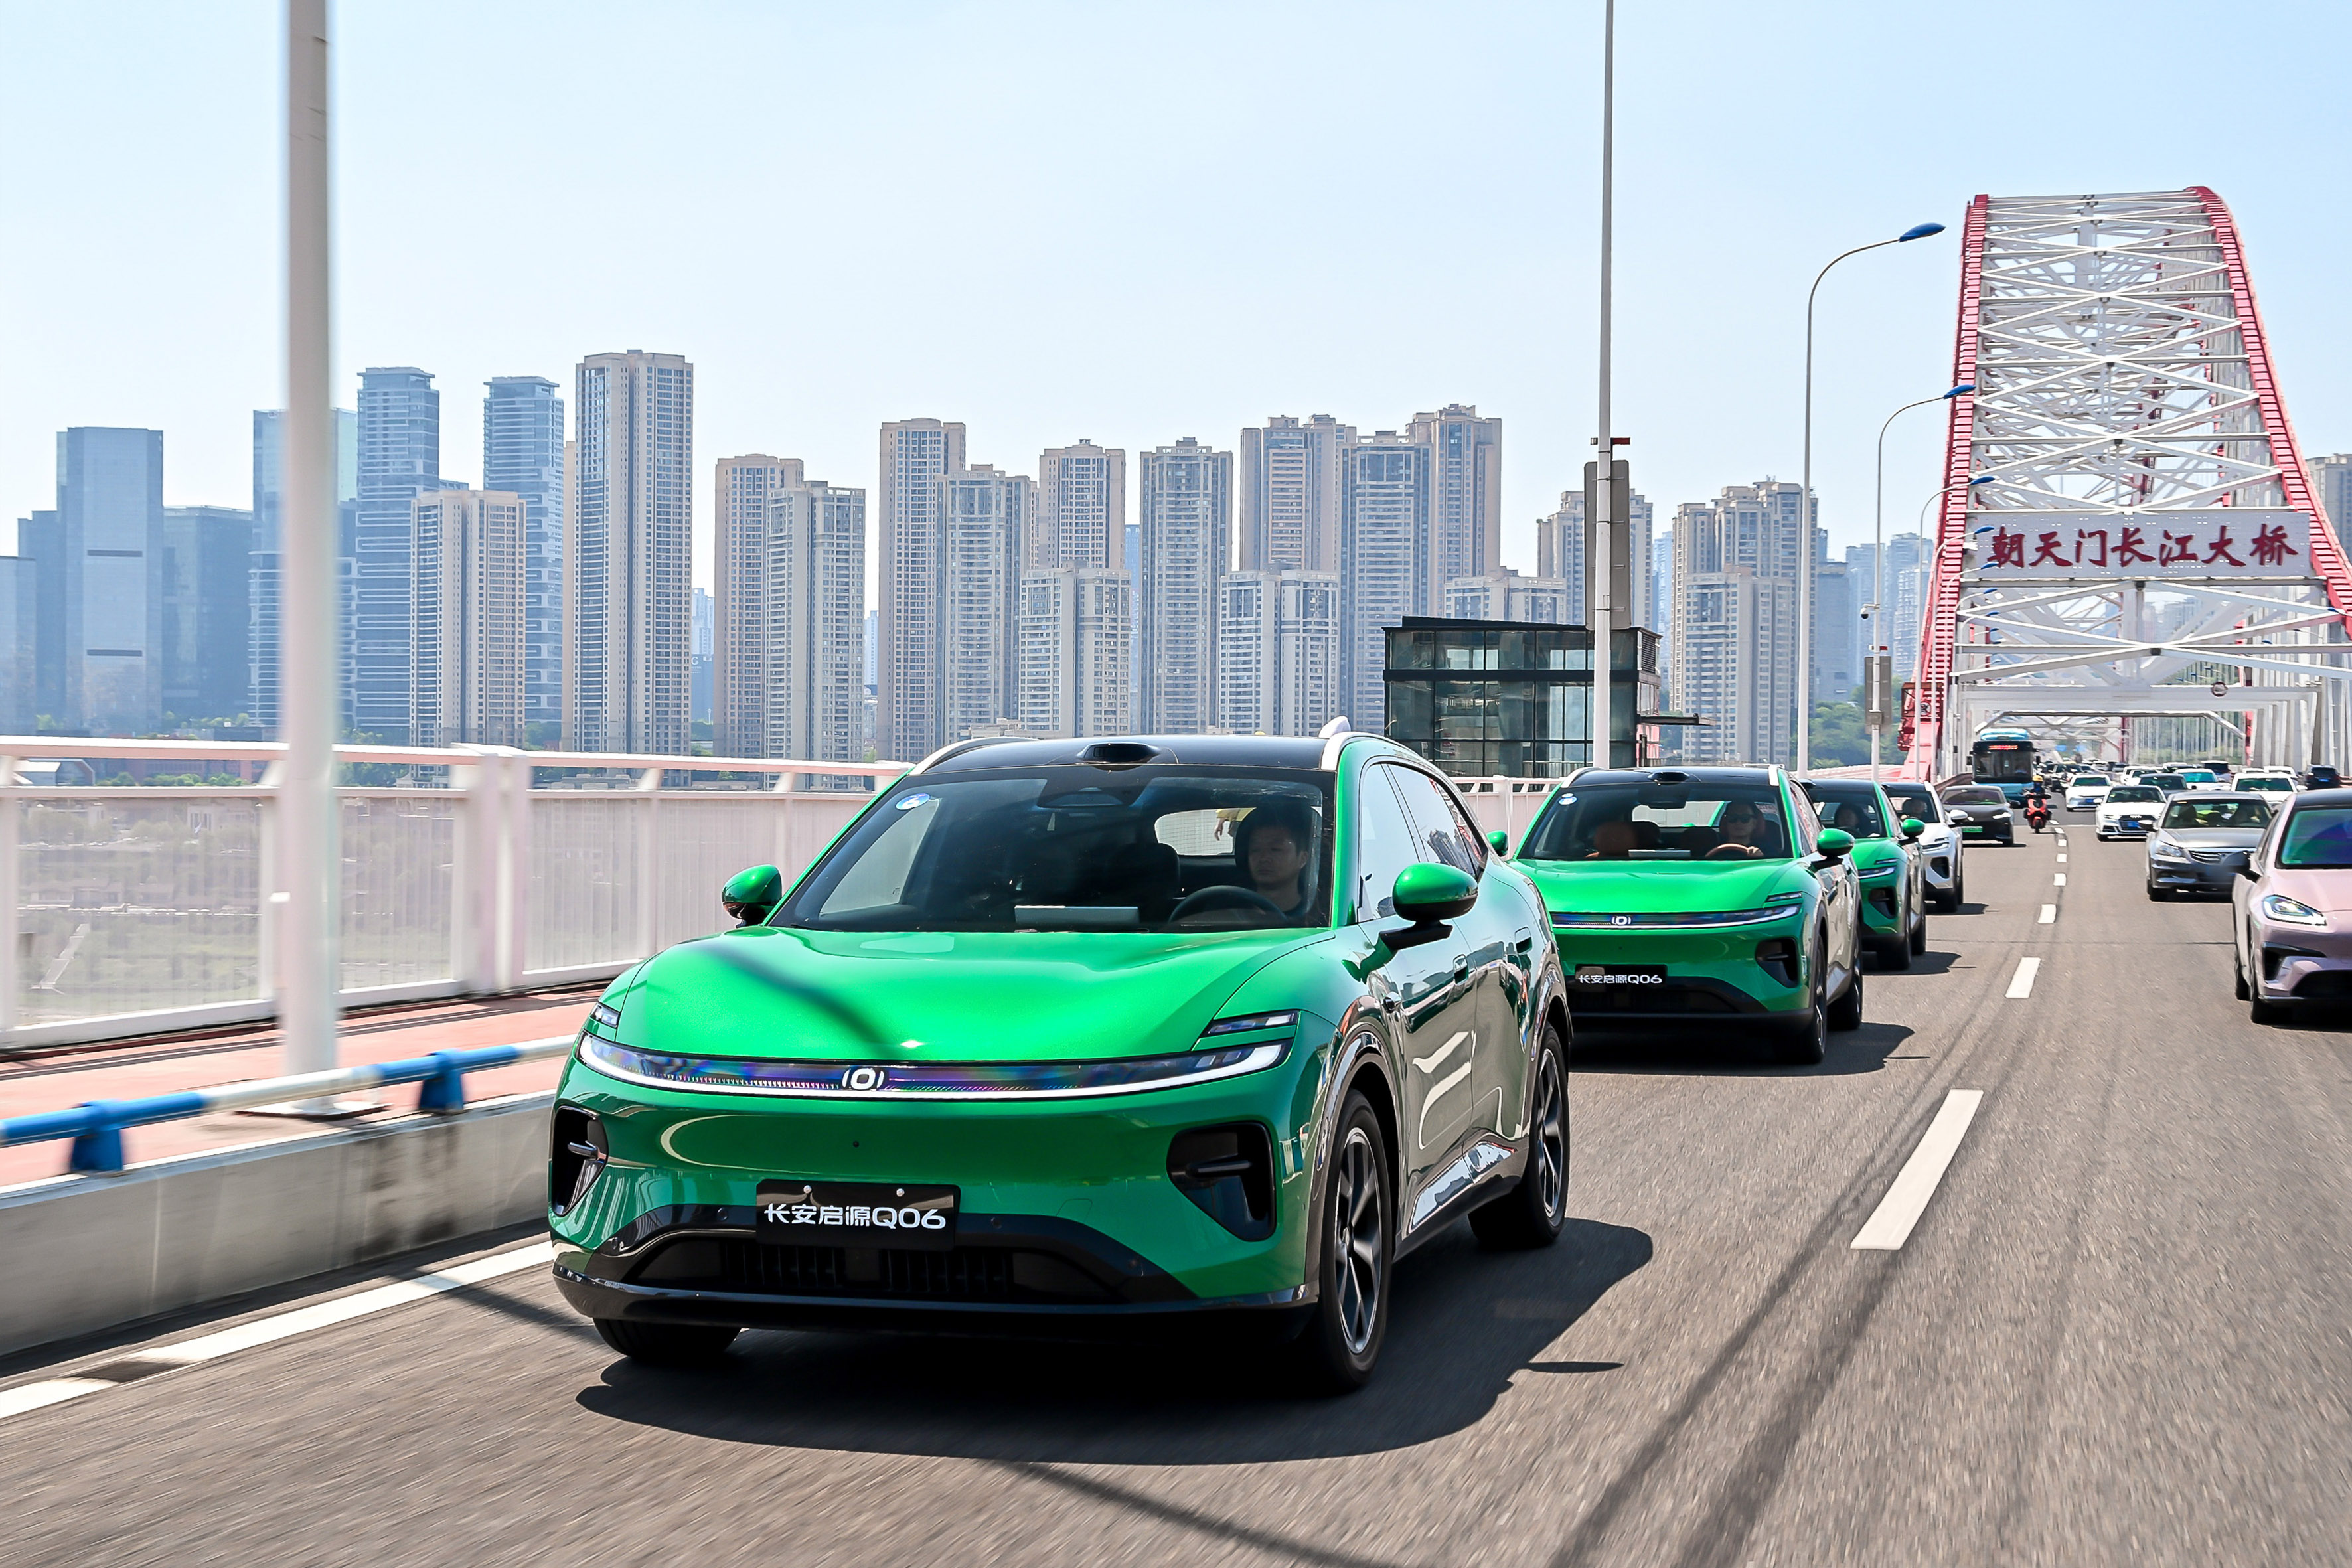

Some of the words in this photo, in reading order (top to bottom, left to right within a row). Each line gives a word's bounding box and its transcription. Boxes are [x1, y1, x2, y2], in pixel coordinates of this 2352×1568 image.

[1987, 522, 2299, 568] 朝天门长江大桥
[1578, 974, 1662, 984] 长安启源Q06
[763, 1202, 947, 1229] 长安启源Q06
